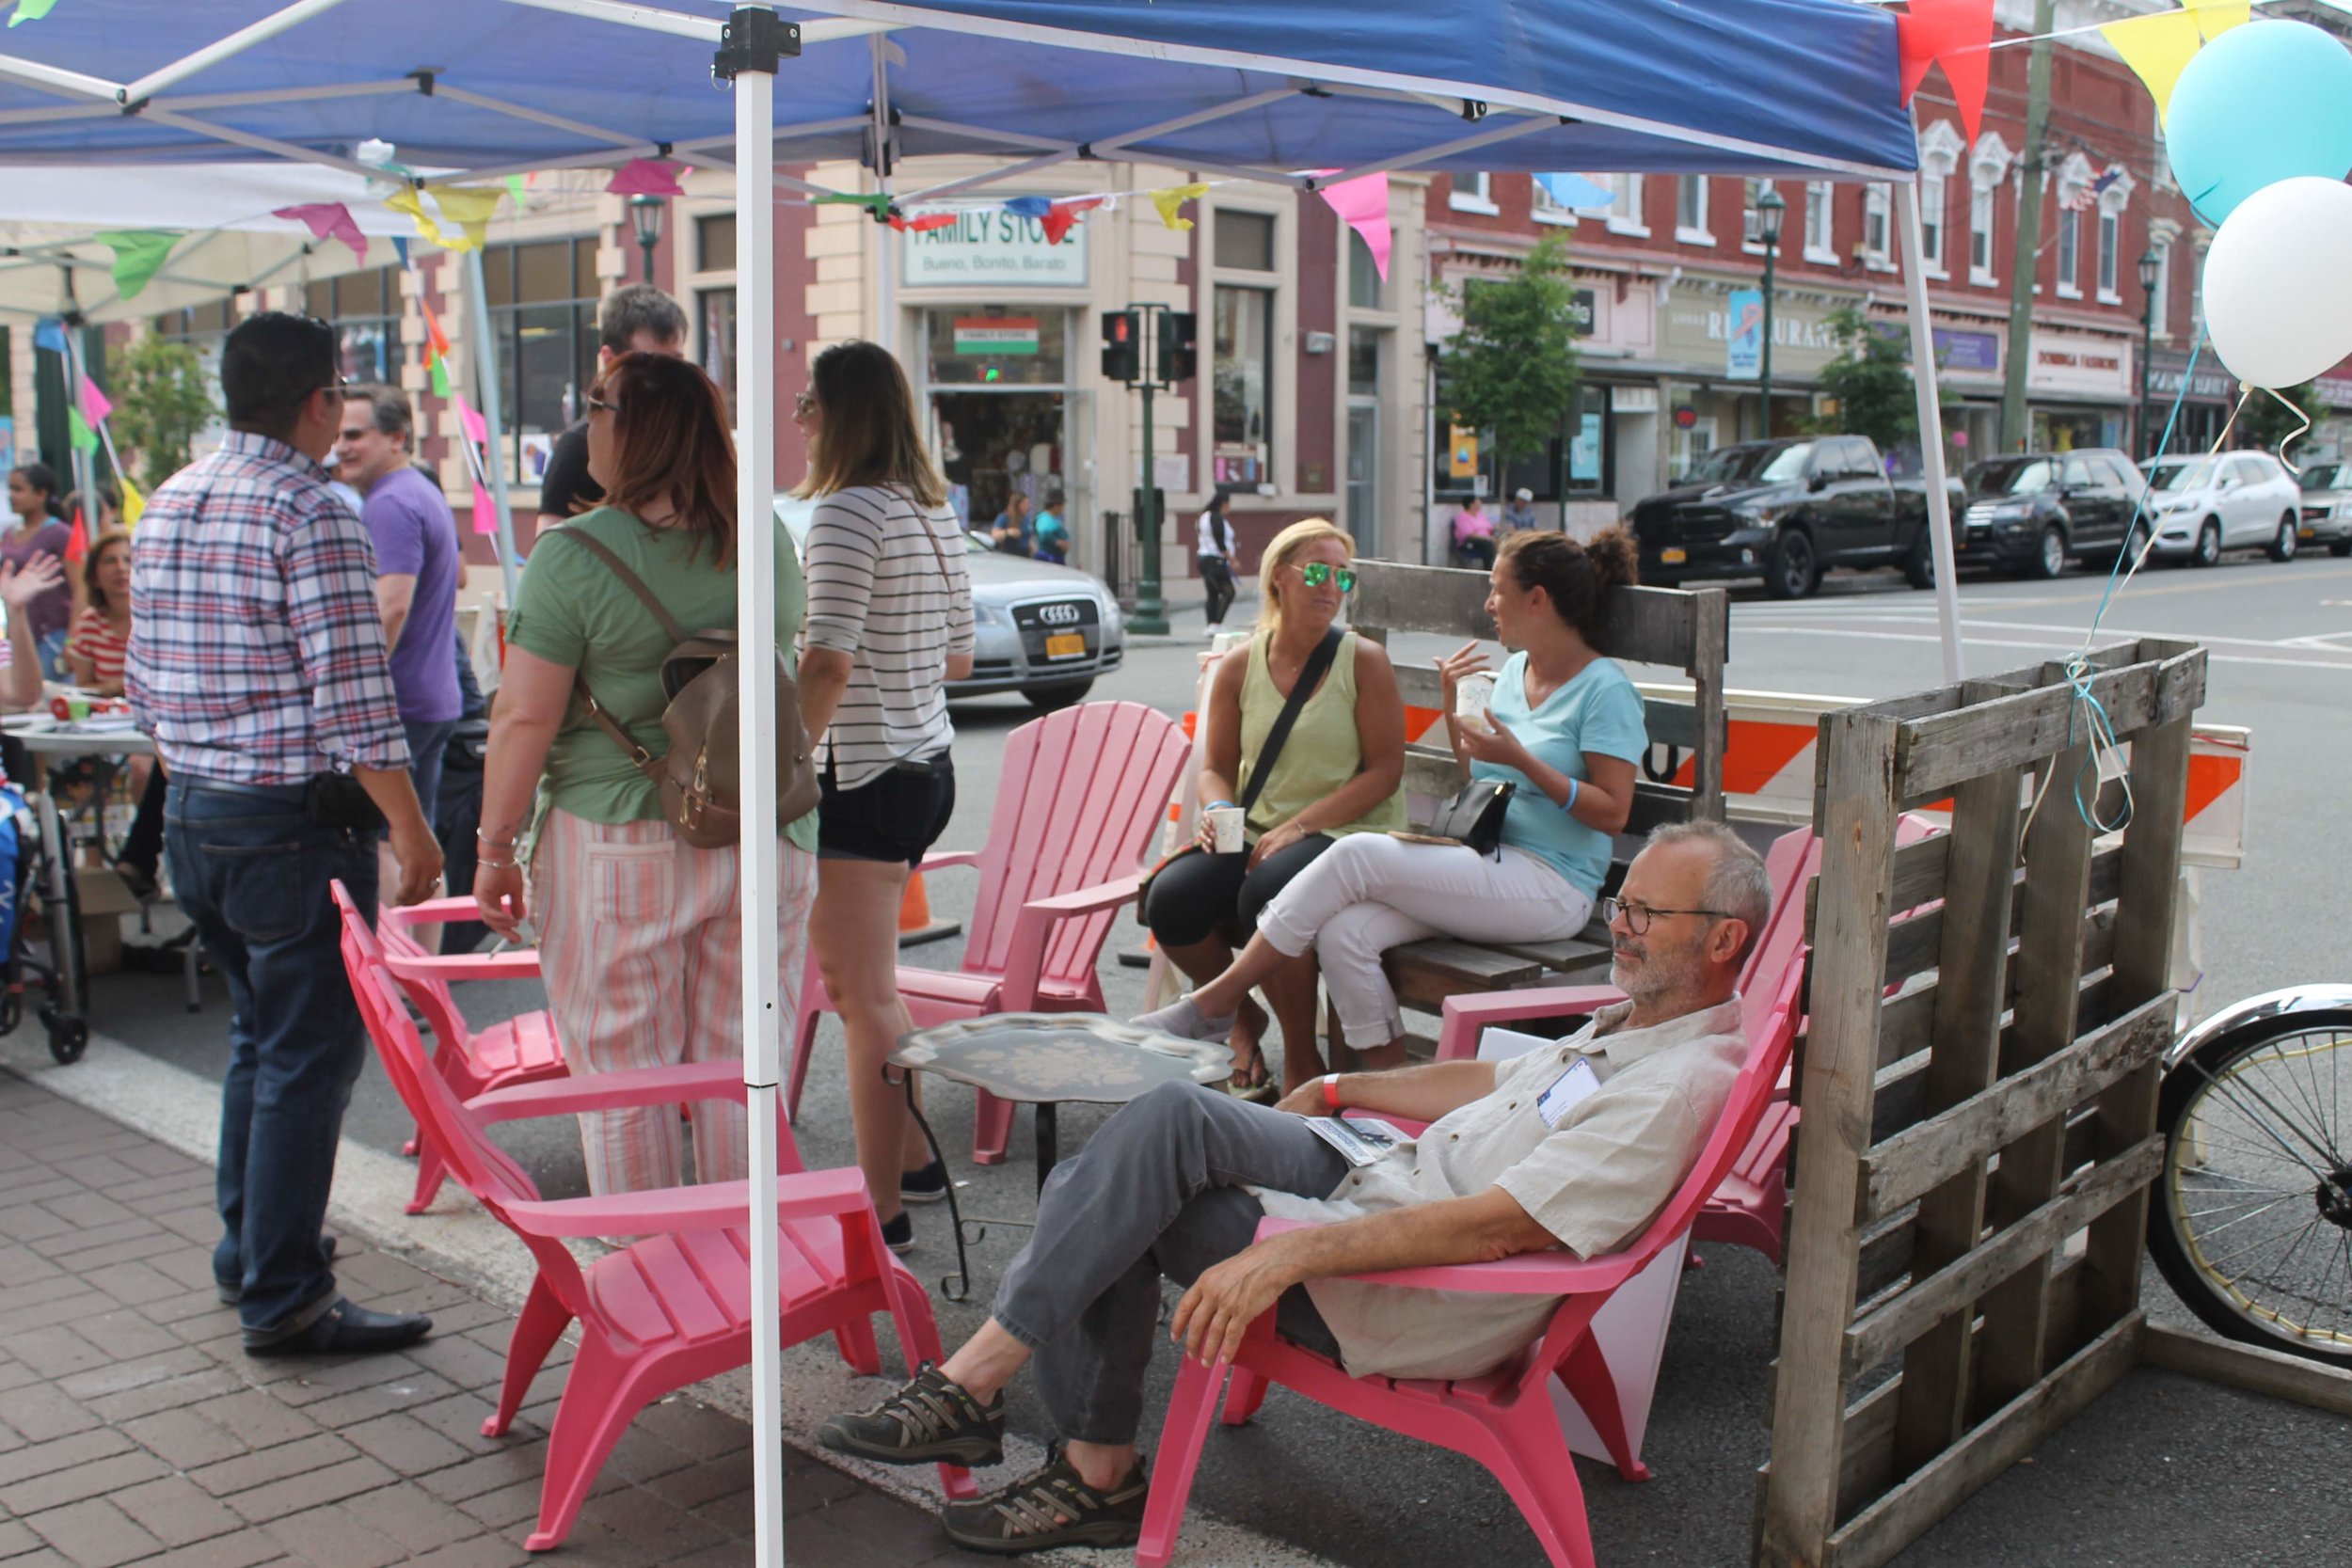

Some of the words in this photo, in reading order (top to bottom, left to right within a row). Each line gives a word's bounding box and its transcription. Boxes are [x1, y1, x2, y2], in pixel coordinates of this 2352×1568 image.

[999, 209, 1074, 244] STO
[923, 256, 967, 272] Bueno,
[973, 255, 1018, 271] Bonito,
[1023, 255, 1066, 271] Barato
